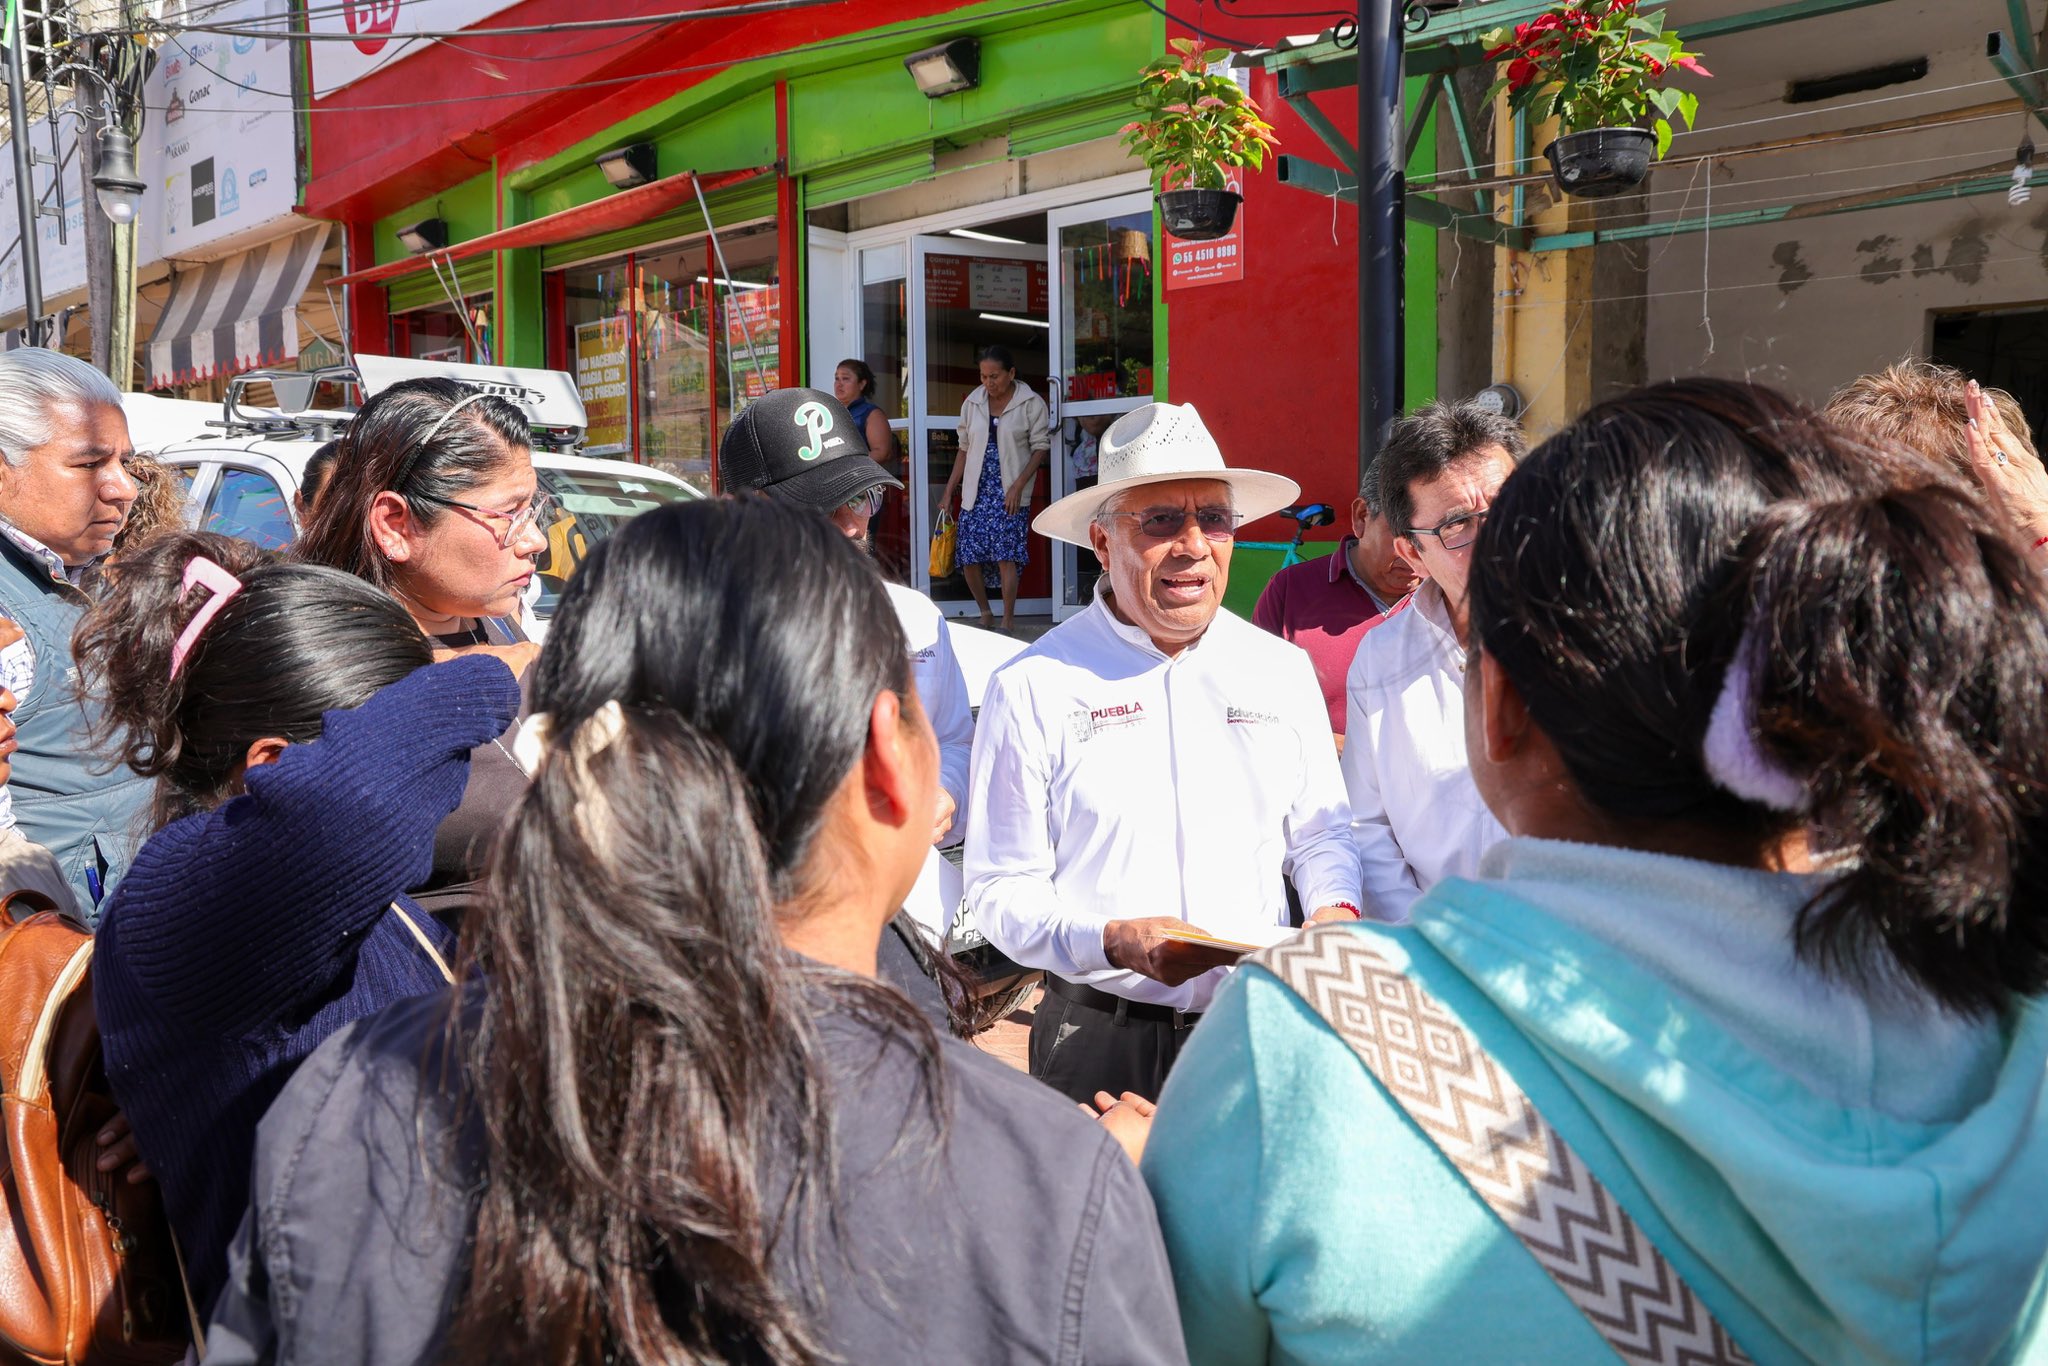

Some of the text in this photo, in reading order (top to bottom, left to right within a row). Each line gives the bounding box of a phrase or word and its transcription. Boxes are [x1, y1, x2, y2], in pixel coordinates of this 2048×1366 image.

[1183, 251, 1193, 263] 55
[579, 351, 625, 371] NO HACEMOS
[580, 367, 620, 386] MAGIA CON
[581, 382, 626, 401] LOS PRECIOS
[794, 402, 834, 461] P
[1090, 701, 1143, 722] PUEBLA
